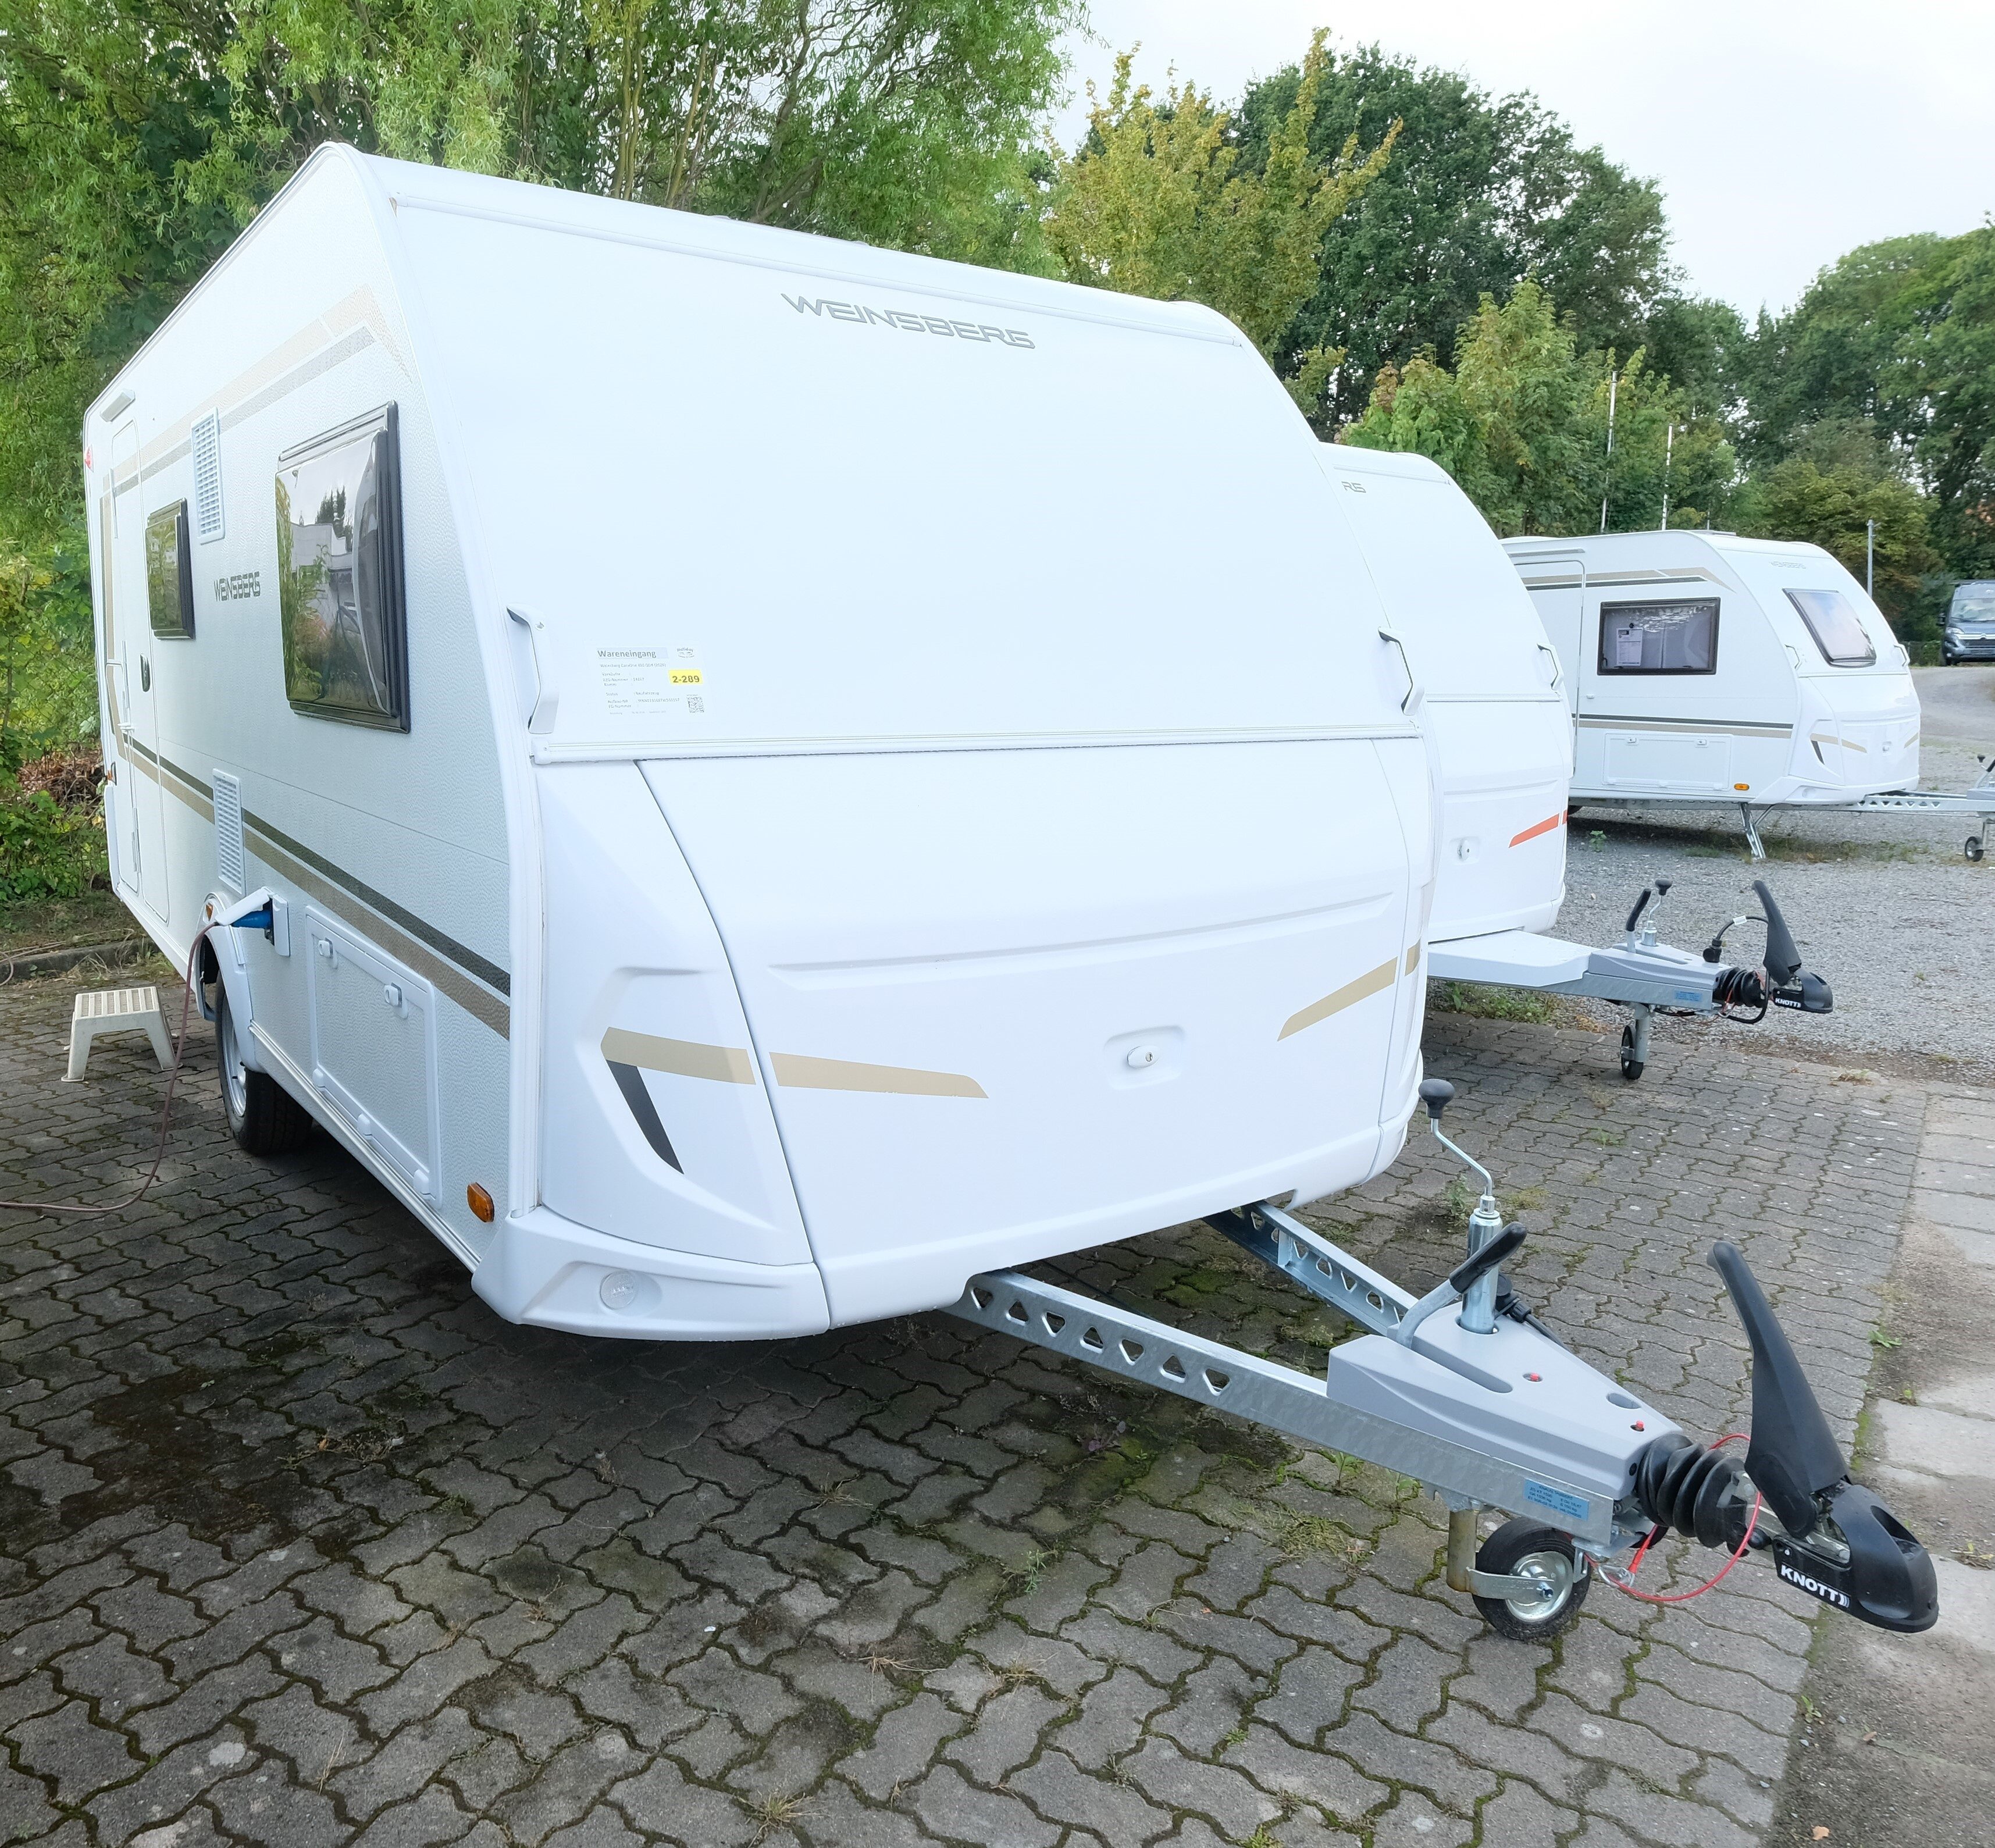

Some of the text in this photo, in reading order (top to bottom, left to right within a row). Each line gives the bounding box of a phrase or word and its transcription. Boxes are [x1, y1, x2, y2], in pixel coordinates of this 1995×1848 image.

[781, 293, 1035, 349] WEINSBERG
[213, 571, 261, 601] WEINSBERG
[597, 650, 657, 658] Wareneingang
[672, 675, 700, 683] 2-289
[1775, 998, 1798, 1007] KNOTT
[1780, 1564, 1839, 1602] KNOTT
